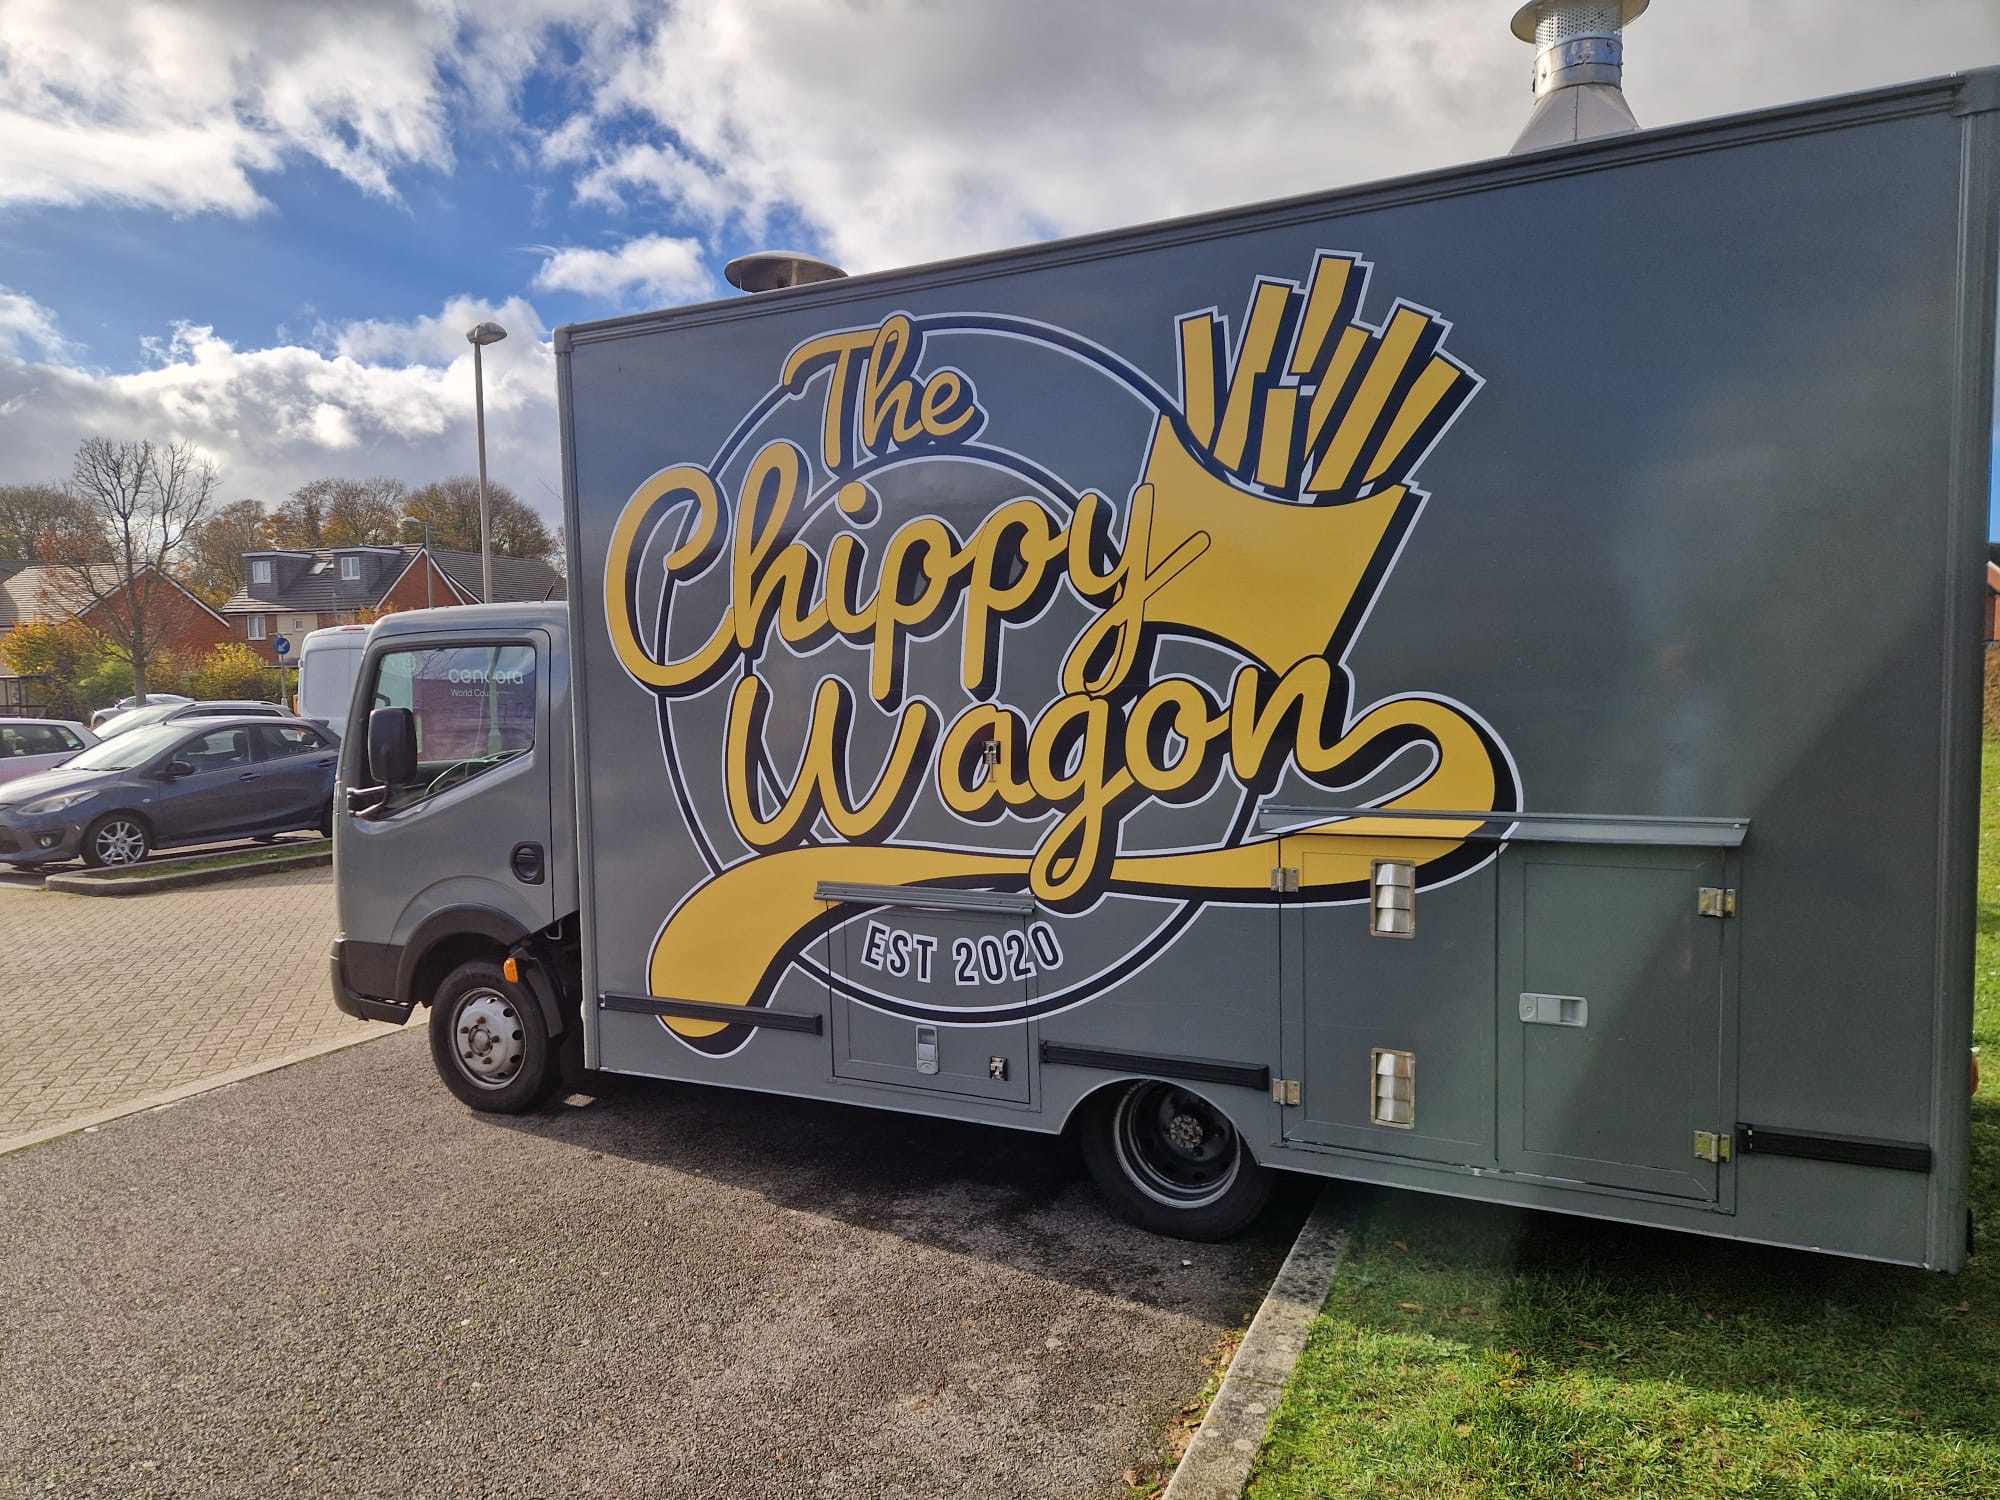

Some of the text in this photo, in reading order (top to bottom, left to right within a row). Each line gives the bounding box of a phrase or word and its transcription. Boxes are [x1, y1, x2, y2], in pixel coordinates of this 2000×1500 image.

[780, 312, 985, 472] The
[604, 441, 1212, 704] Chippy
[450, 687, 473, 697] World
[723, 655, 1350, 905] Wagon
[861, 920, 1064, 986] EST 2020
